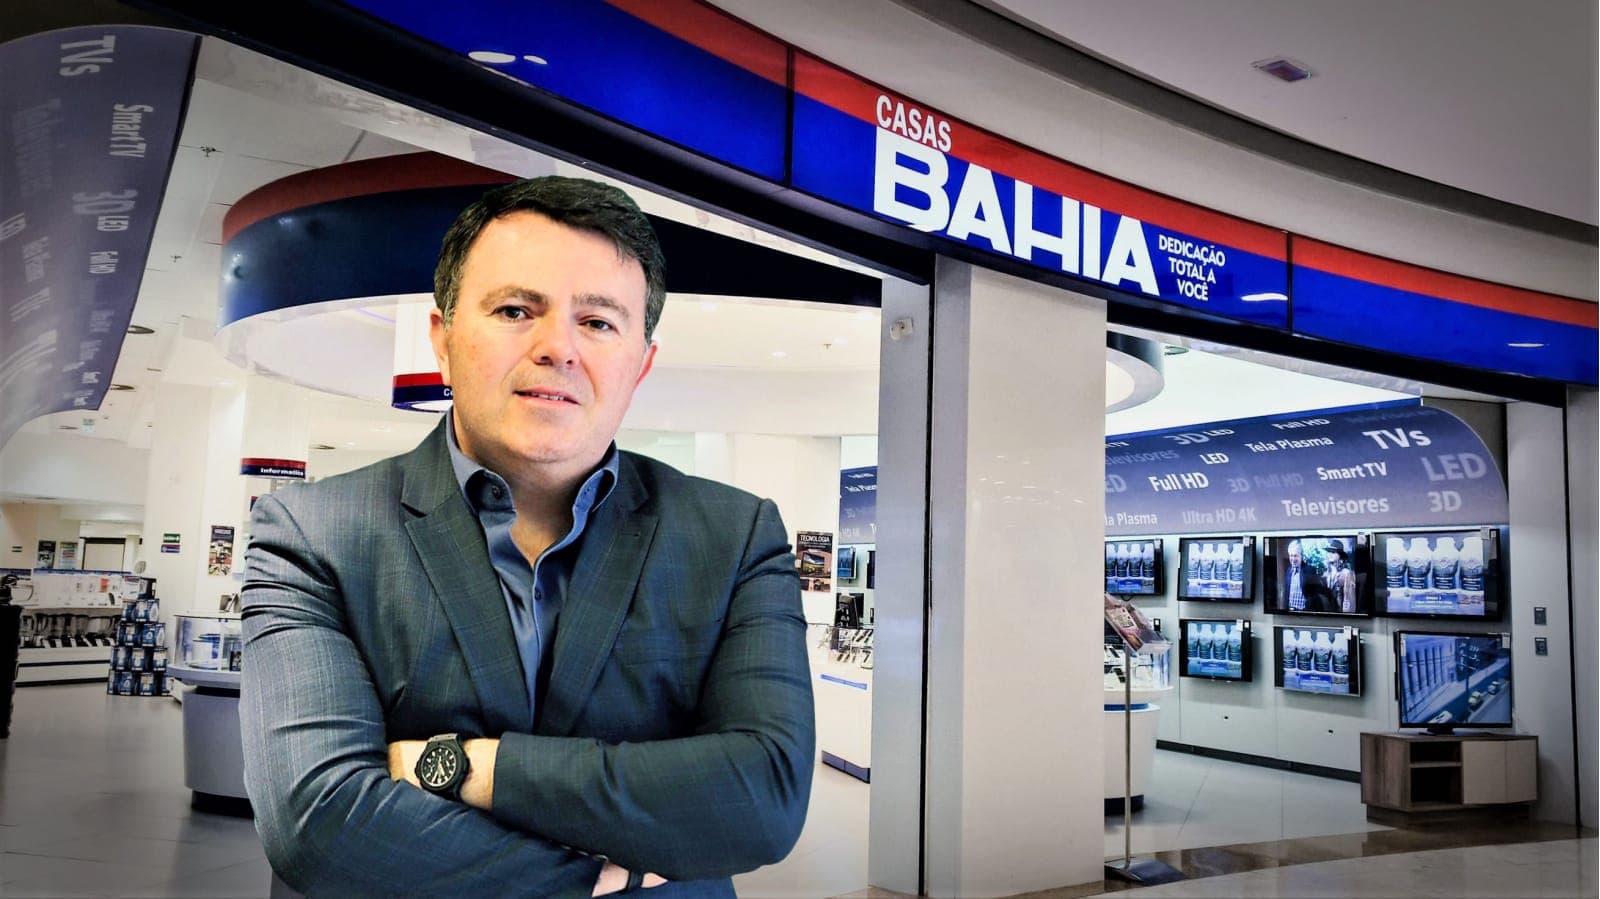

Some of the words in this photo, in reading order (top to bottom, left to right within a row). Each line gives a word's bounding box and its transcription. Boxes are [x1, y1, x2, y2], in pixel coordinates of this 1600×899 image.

[60, 35, 116, 77] TVs
[110, 104, 154, 141] Smart
[876, 95, 951, 152] CASAS
[109, 142, 147, 158] TV
[72, 189, 138, 215] 3D
[873, 126, 1160, 296] BAHIA
[97, 215, 130, 232] LED
[1159, 234, 1226, 266] DEDICAÇÃO
[1168, 256, 1206, 283] TOTAL
[1205, 269, 1217, 284] A
[1177, 279, 1209, 301] VOCÊ
[1303, 418, 1331, 428] HD
[1163, 432, 1210, 445] 3D
[1203, 429, 1235, 437] LED
[1244, 442, 1278, 453] Tela
[1277, 437, 1334, 449] Plasma
[1362, 428, 1432, 449] TVs
[1200, 453, 1230, 465] LED
[1421, 453, 1487, 481] LED
[1317, 465, 1366, 481] Smart
[1364, 462, 1388, 477] TV
[1148, 473, 1182, 492] Full
[1182, 472, 1209, 488] HD
[1227, 478, 1250, 493] 3D
[1281, 497, 1390, 517] Televisores
[1428, 491, 1462, 513] 3D
[1116, 512, 1158, 526] Plasma
[1182, 509, 1214, 525] Ultra
[1215, 508, 1236, 523] HD
[1238, 507, 1257, 522] 4K
